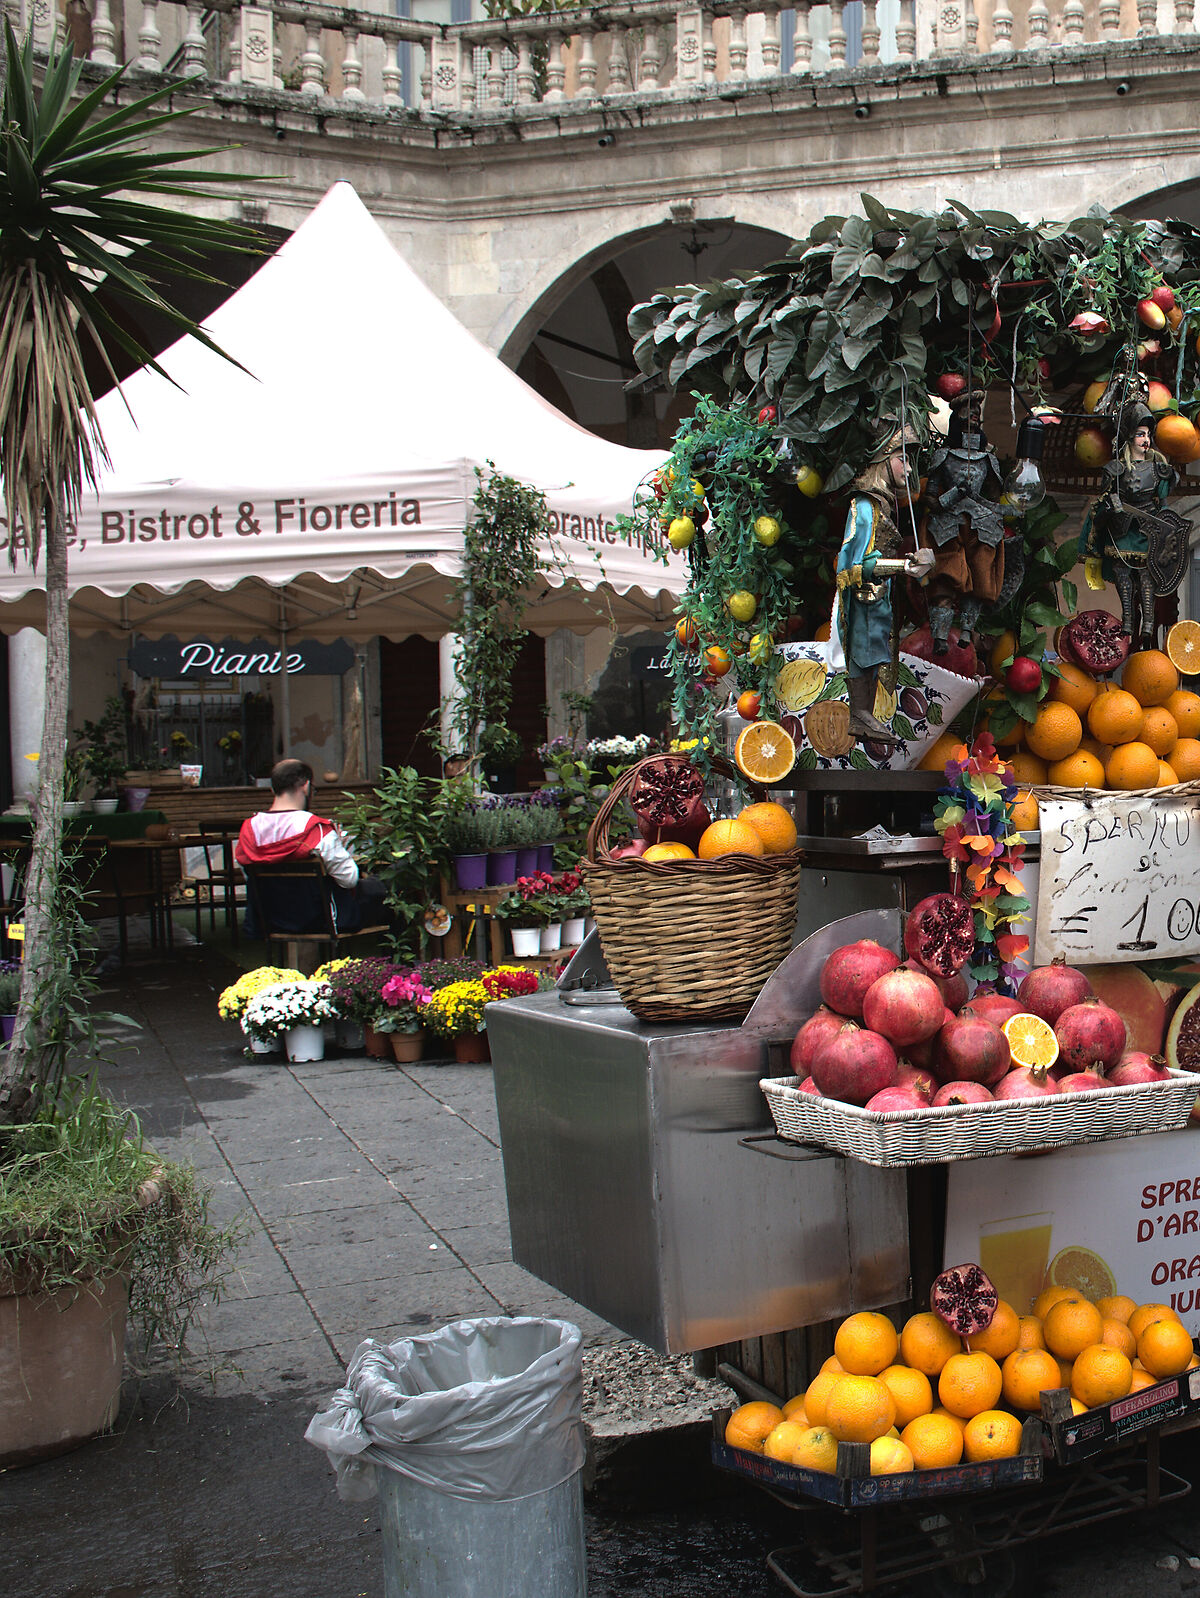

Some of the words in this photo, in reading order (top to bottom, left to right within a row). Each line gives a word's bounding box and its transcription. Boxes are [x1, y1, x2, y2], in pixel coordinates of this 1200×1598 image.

[101, 505, 223, 544] Bistrot
[235, 501, 262, 537] &
[274, 491, 422, 534] Fioreria
[1124, 1384, 1175, 1412] FRAGOLINO
